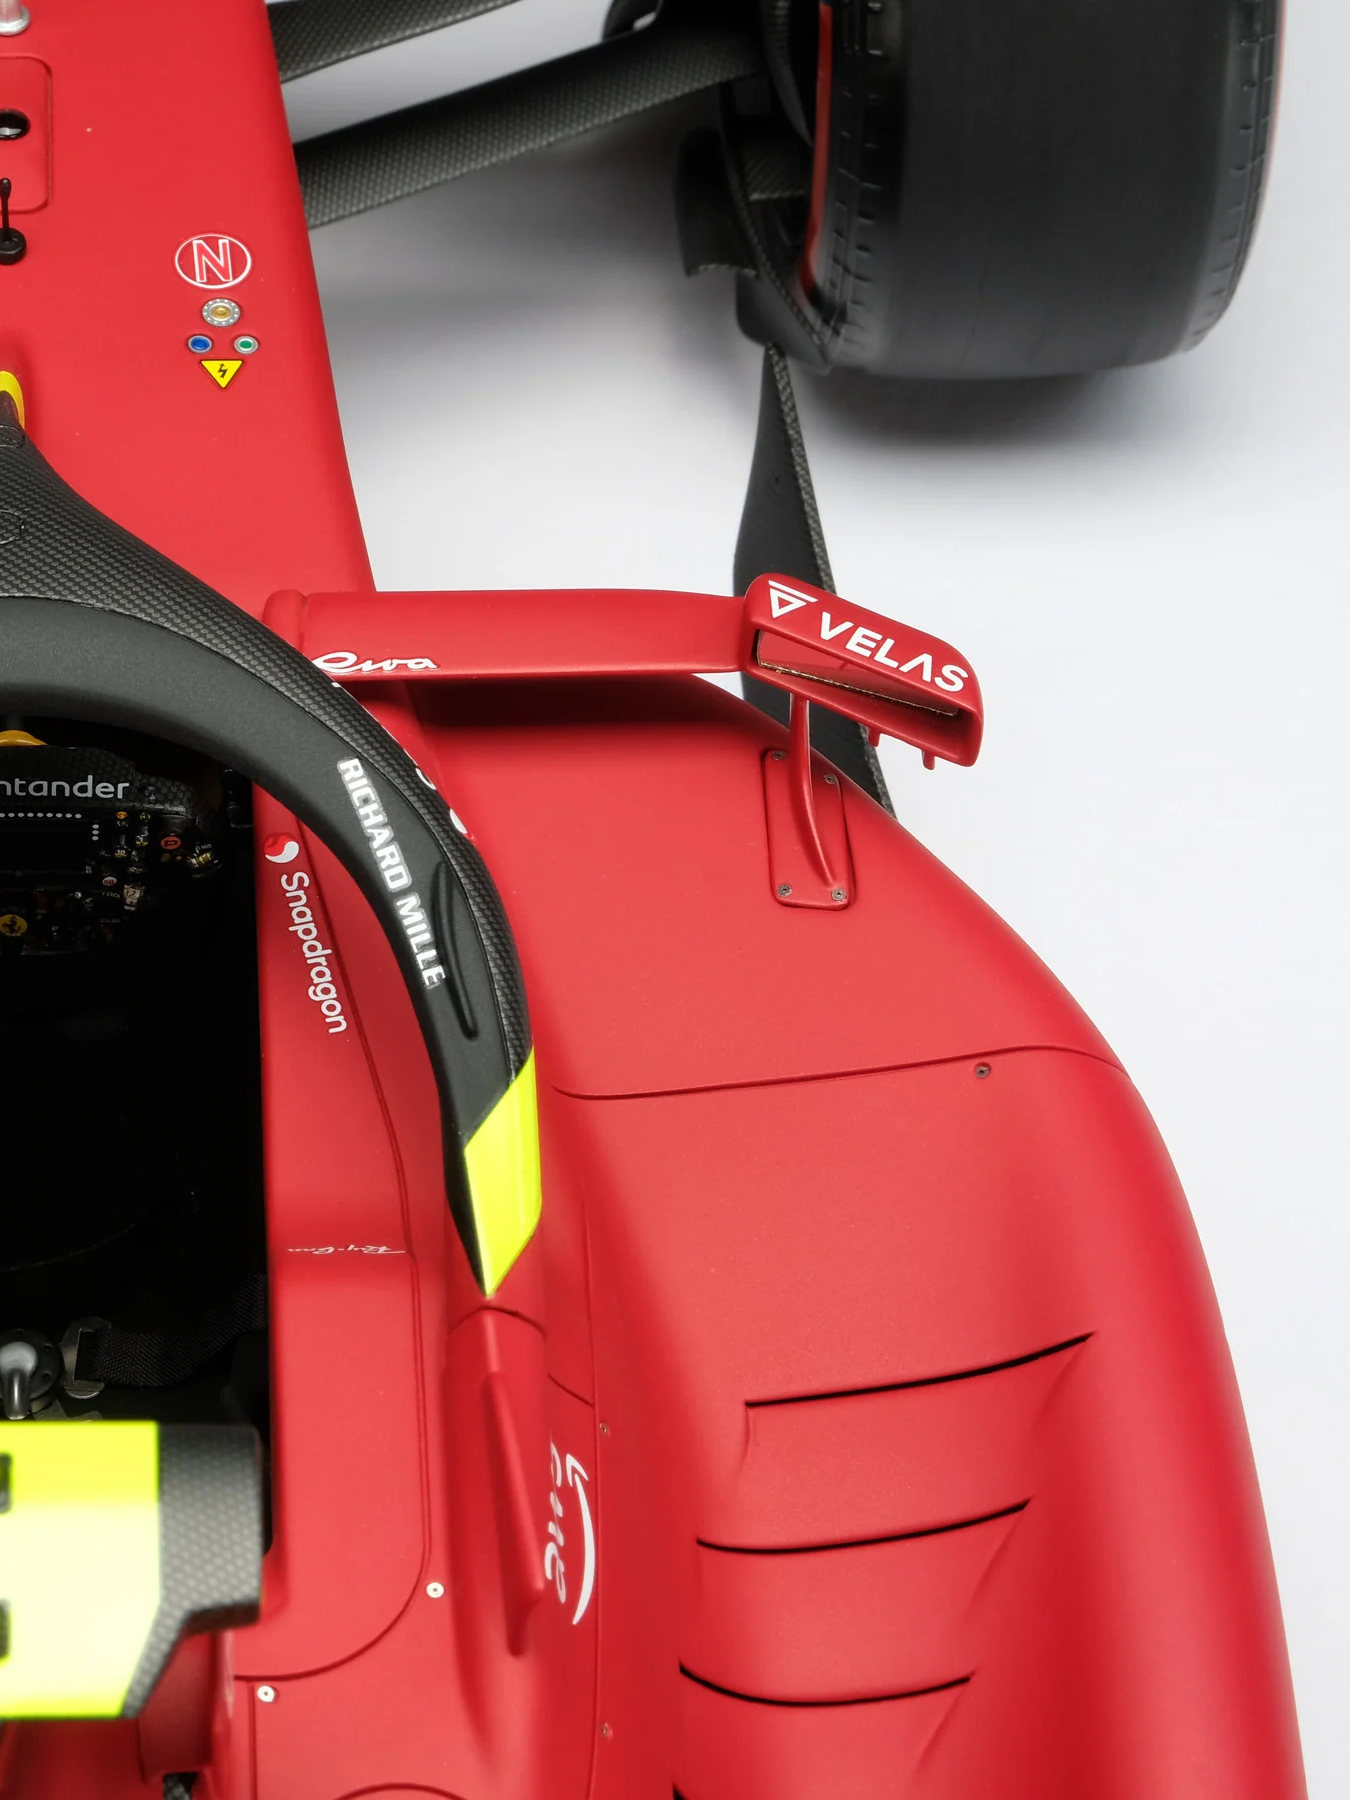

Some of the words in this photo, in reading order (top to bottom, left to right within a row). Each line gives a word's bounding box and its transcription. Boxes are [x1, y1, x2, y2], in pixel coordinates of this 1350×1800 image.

[192, 239, 233, 283] N
[818, 610, 970, 693] VELAS
[337, 757, 412, 892] RICHARD
[394, 892, 446, 988] MILLE
[281, 871, 347, 1034] Snapdragon
